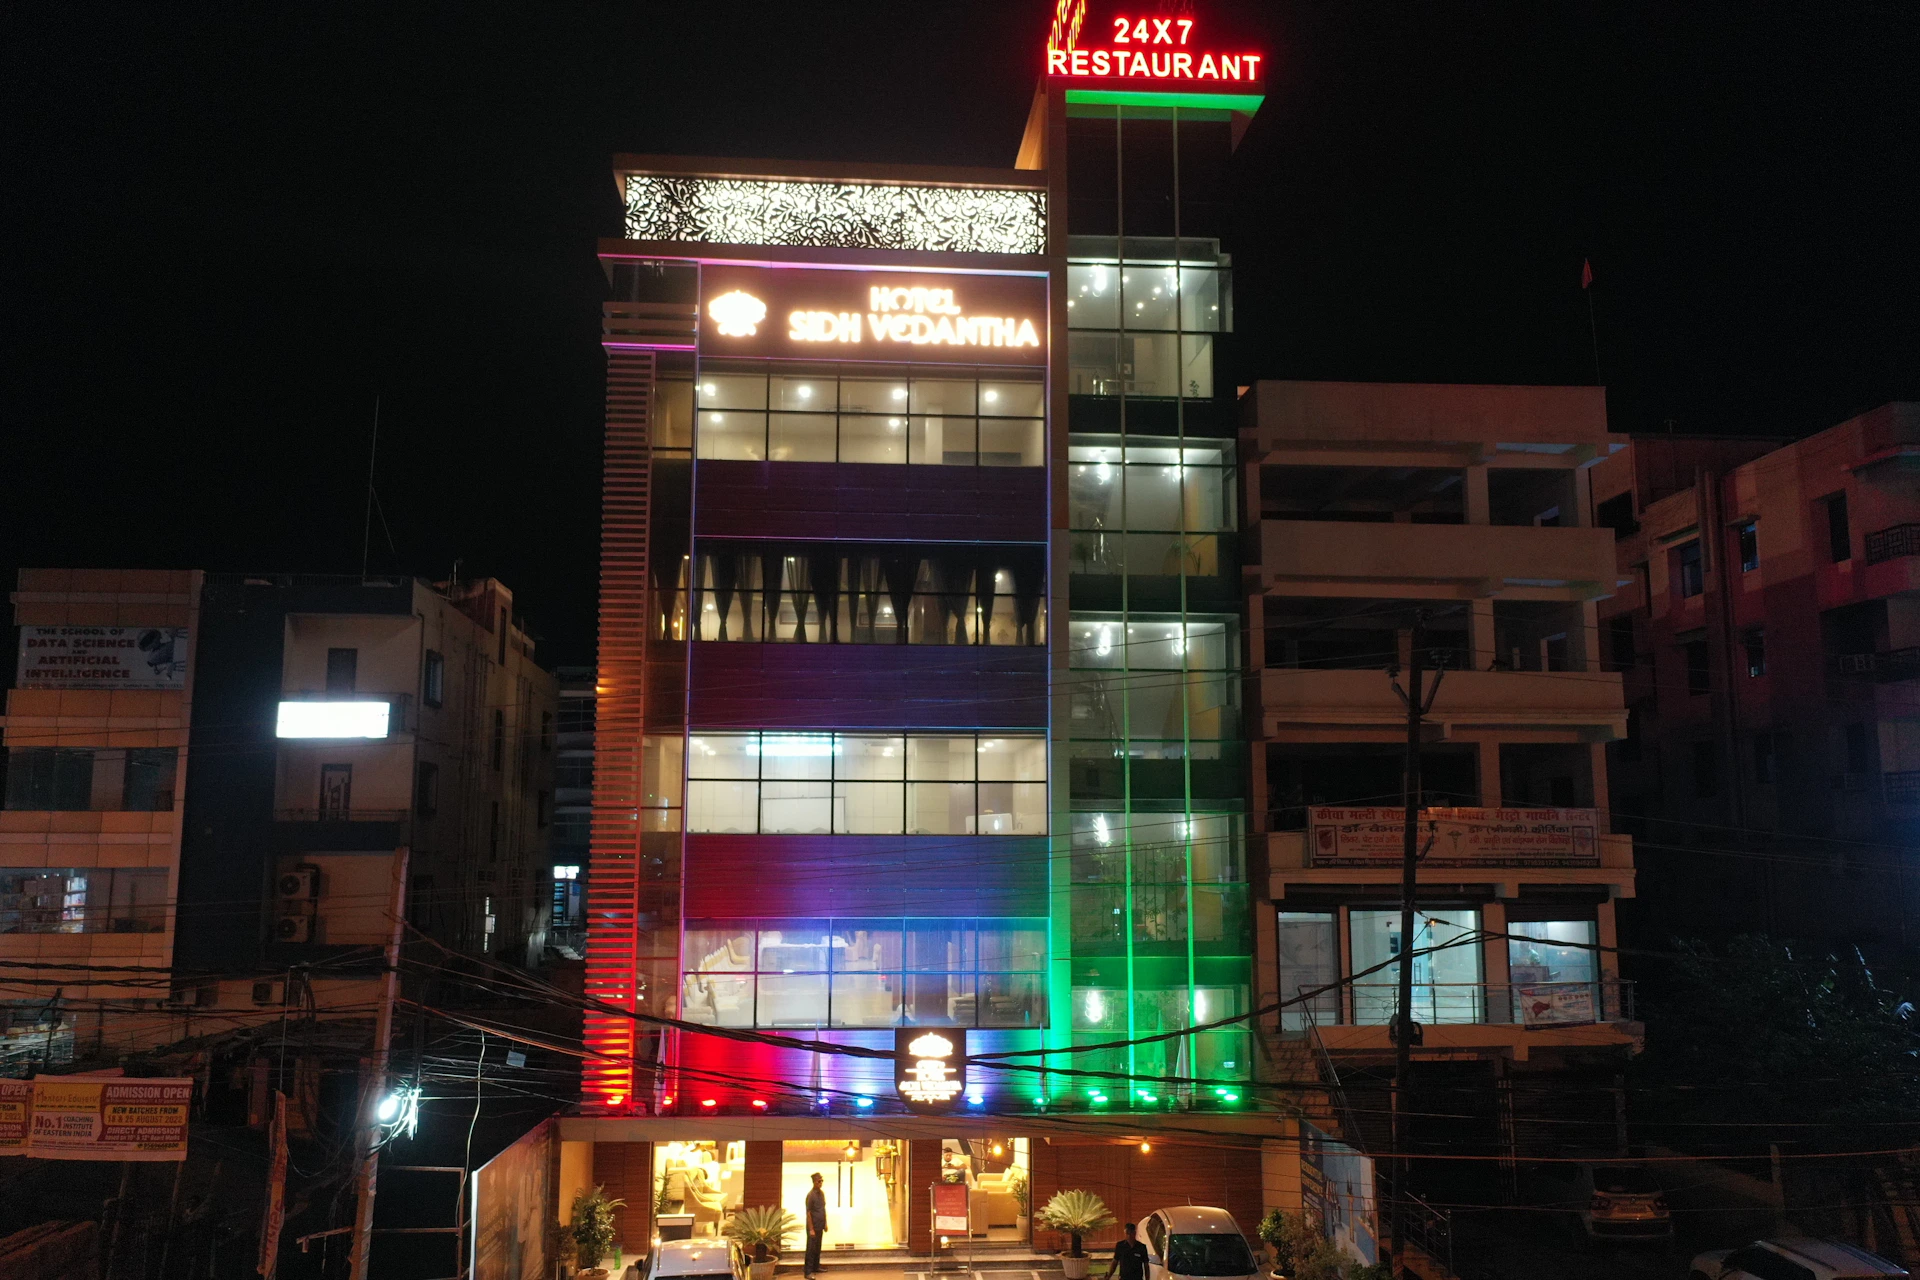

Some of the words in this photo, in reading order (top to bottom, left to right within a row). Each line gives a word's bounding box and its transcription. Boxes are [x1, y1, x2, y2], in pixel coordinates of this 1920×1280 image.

[1114, 17, 1193, 45] 24X7
[1048, 49, 1261, 80] RESTAURANT
[869, 286, 961, 315] HOTEL
[788, 310, 861, 343] SIDH
[868, 313, 1040, 347] VEDANTHA
[61, 628, 106, 636] SCHOOL
[110, 628, 125, 636] OF
[27, 639, 68, 648] DATA
[73, 639, 135, 648] SCIENCE
[38, 656, 121, 665] ARTIFICIAL
[25, 669, 131, 679] INTELLIGENCE
[1316, 809, 1345, 820] कीवा
[1348, 809, 1377, 820] मल्टी
[1, 1084, 28, 1096] OPEN
[105, 1086, 162, 1098] ADMISSION
[163, 1087, 190, 1098] OPEN
[112, 1106, 127, 1114] NEW
[165, 1116, 182, 1124] 2022
[137, 1127, 181, 1135] ADMISSION
